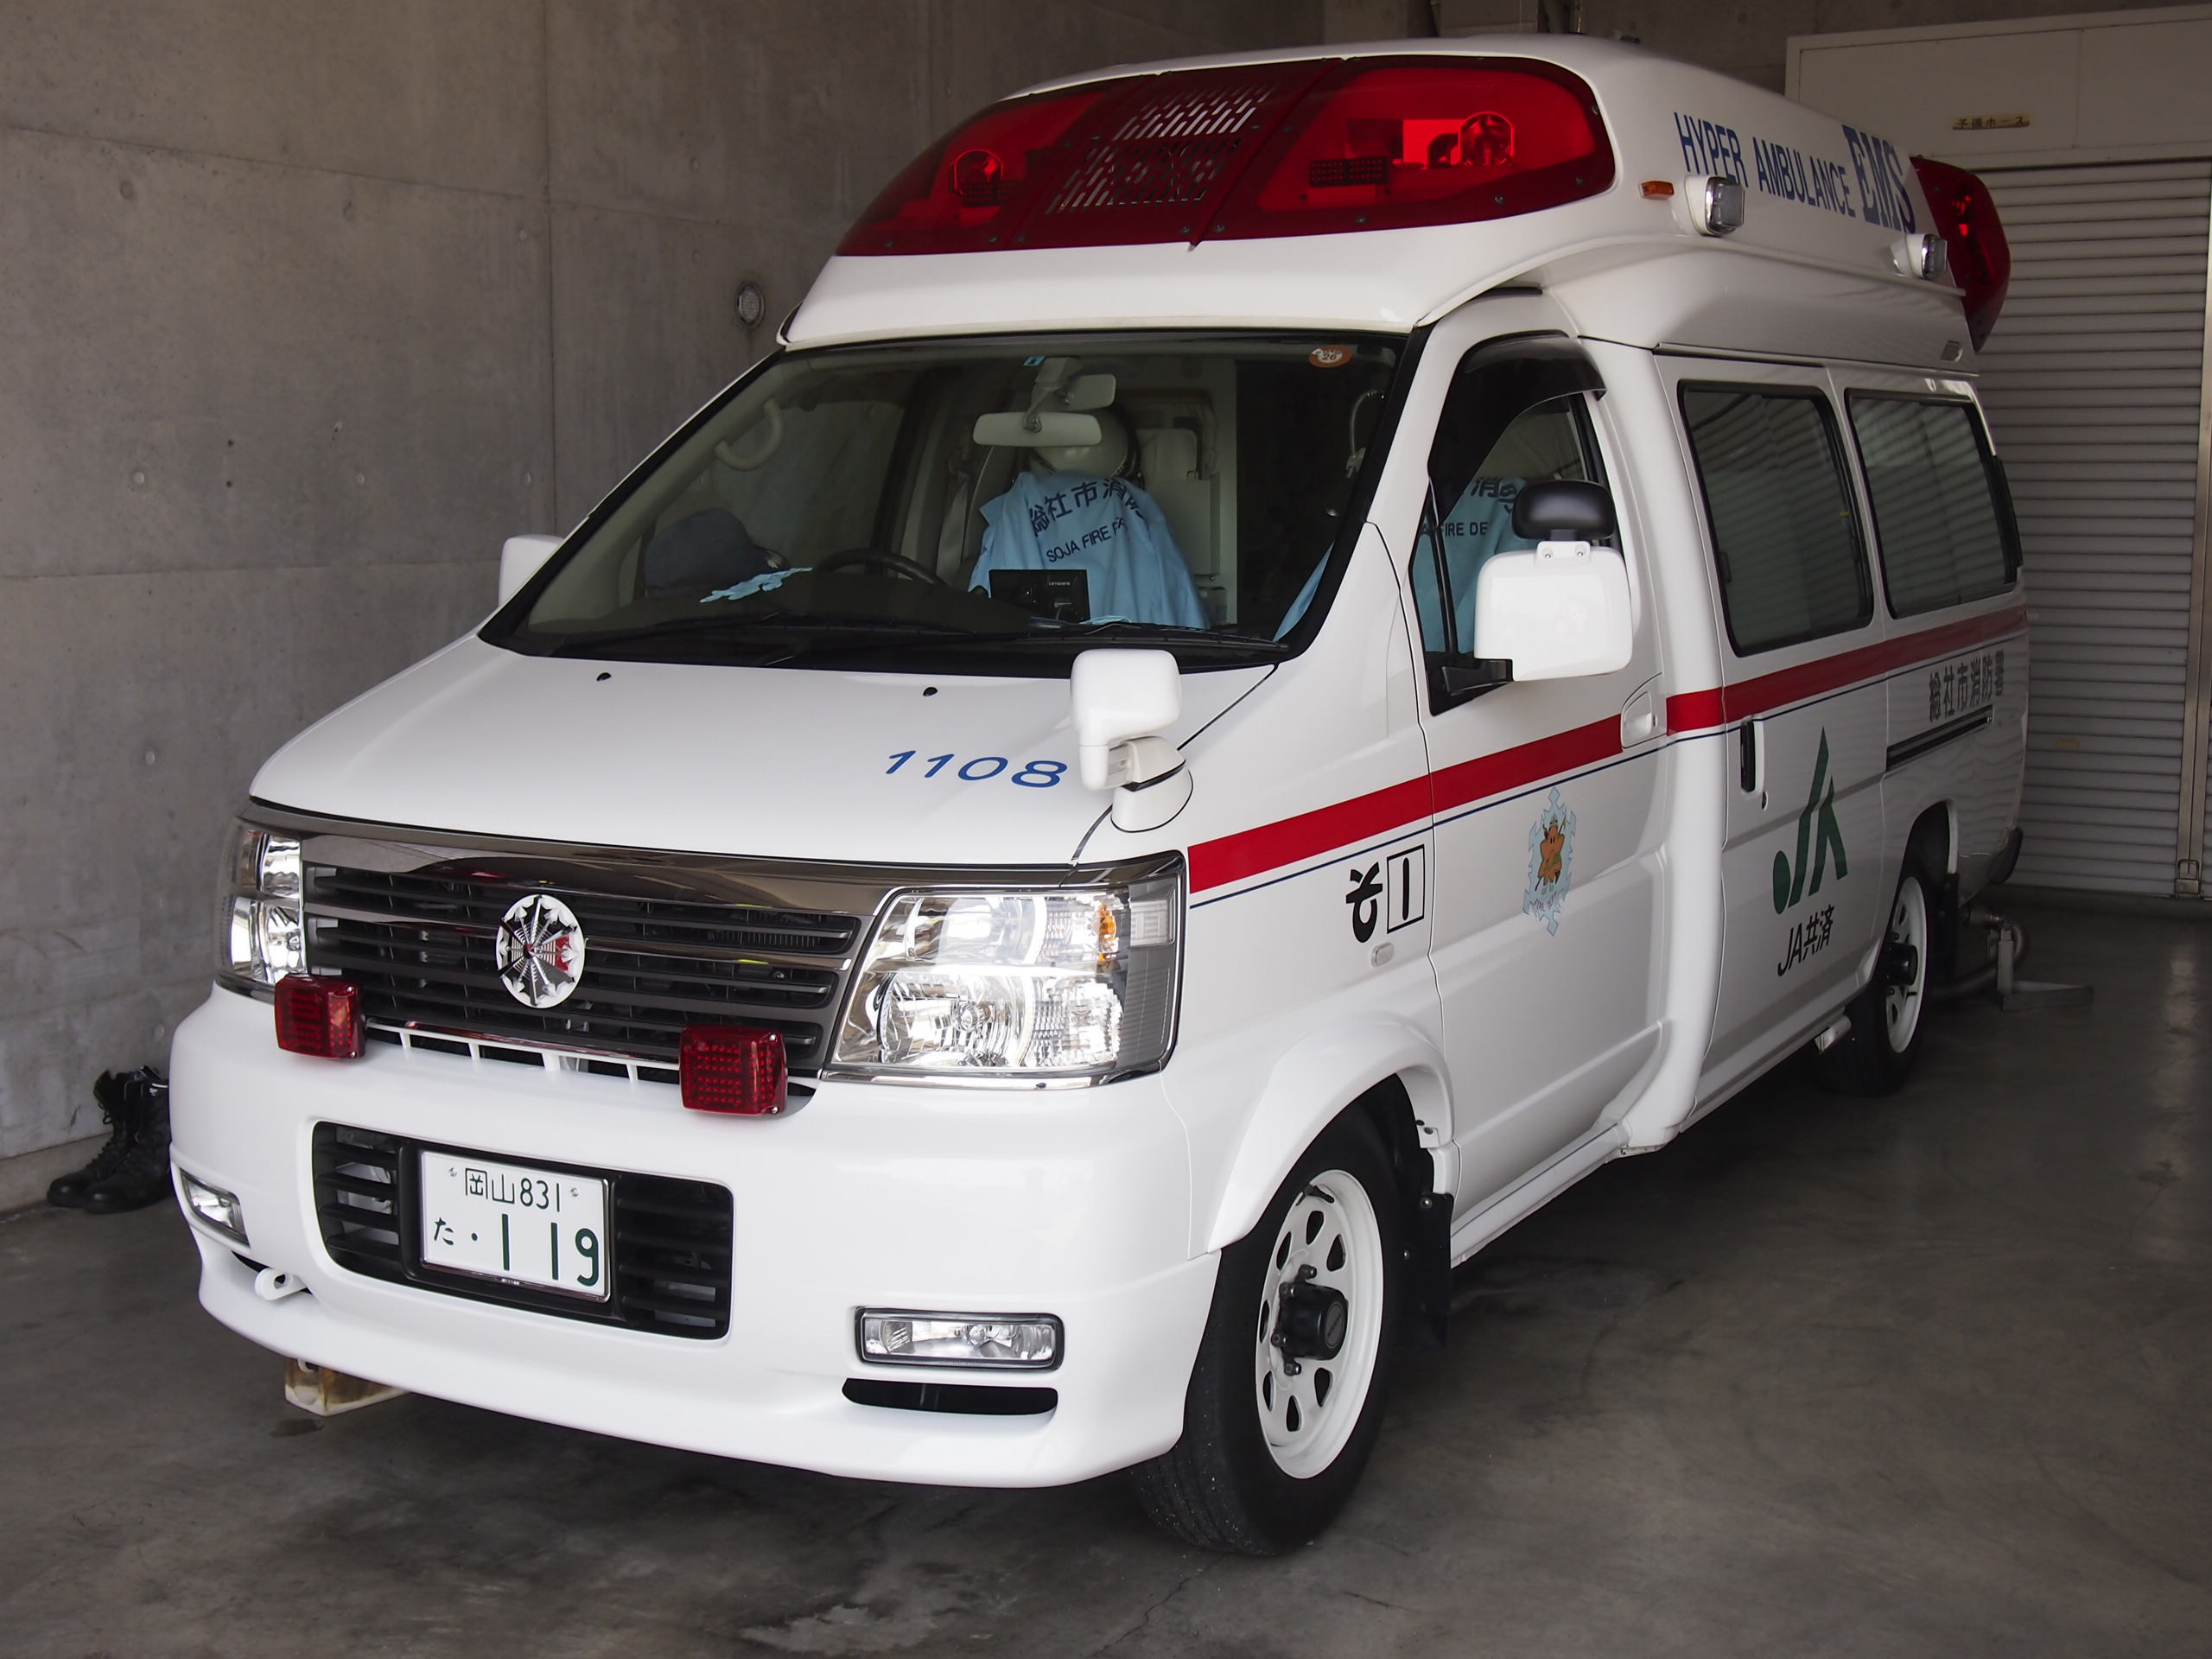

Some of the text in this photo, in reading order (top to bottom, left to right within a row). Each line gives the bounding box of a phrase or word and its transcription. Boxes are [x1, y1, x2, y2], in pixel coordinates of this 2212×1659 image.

[1673, 111, 1916, 234] HYPER AMBULANCE EMS
[1046, 540, 1081, 563] SOJA
[1081, 525, 1112, 549] FIRE
[1440, 522, 1465, 537] IRE
[885, 750, 1068, 788] 1108
[1777, 903, 1835, 977] JA共済
[434, 1217, 454, 1246] た
